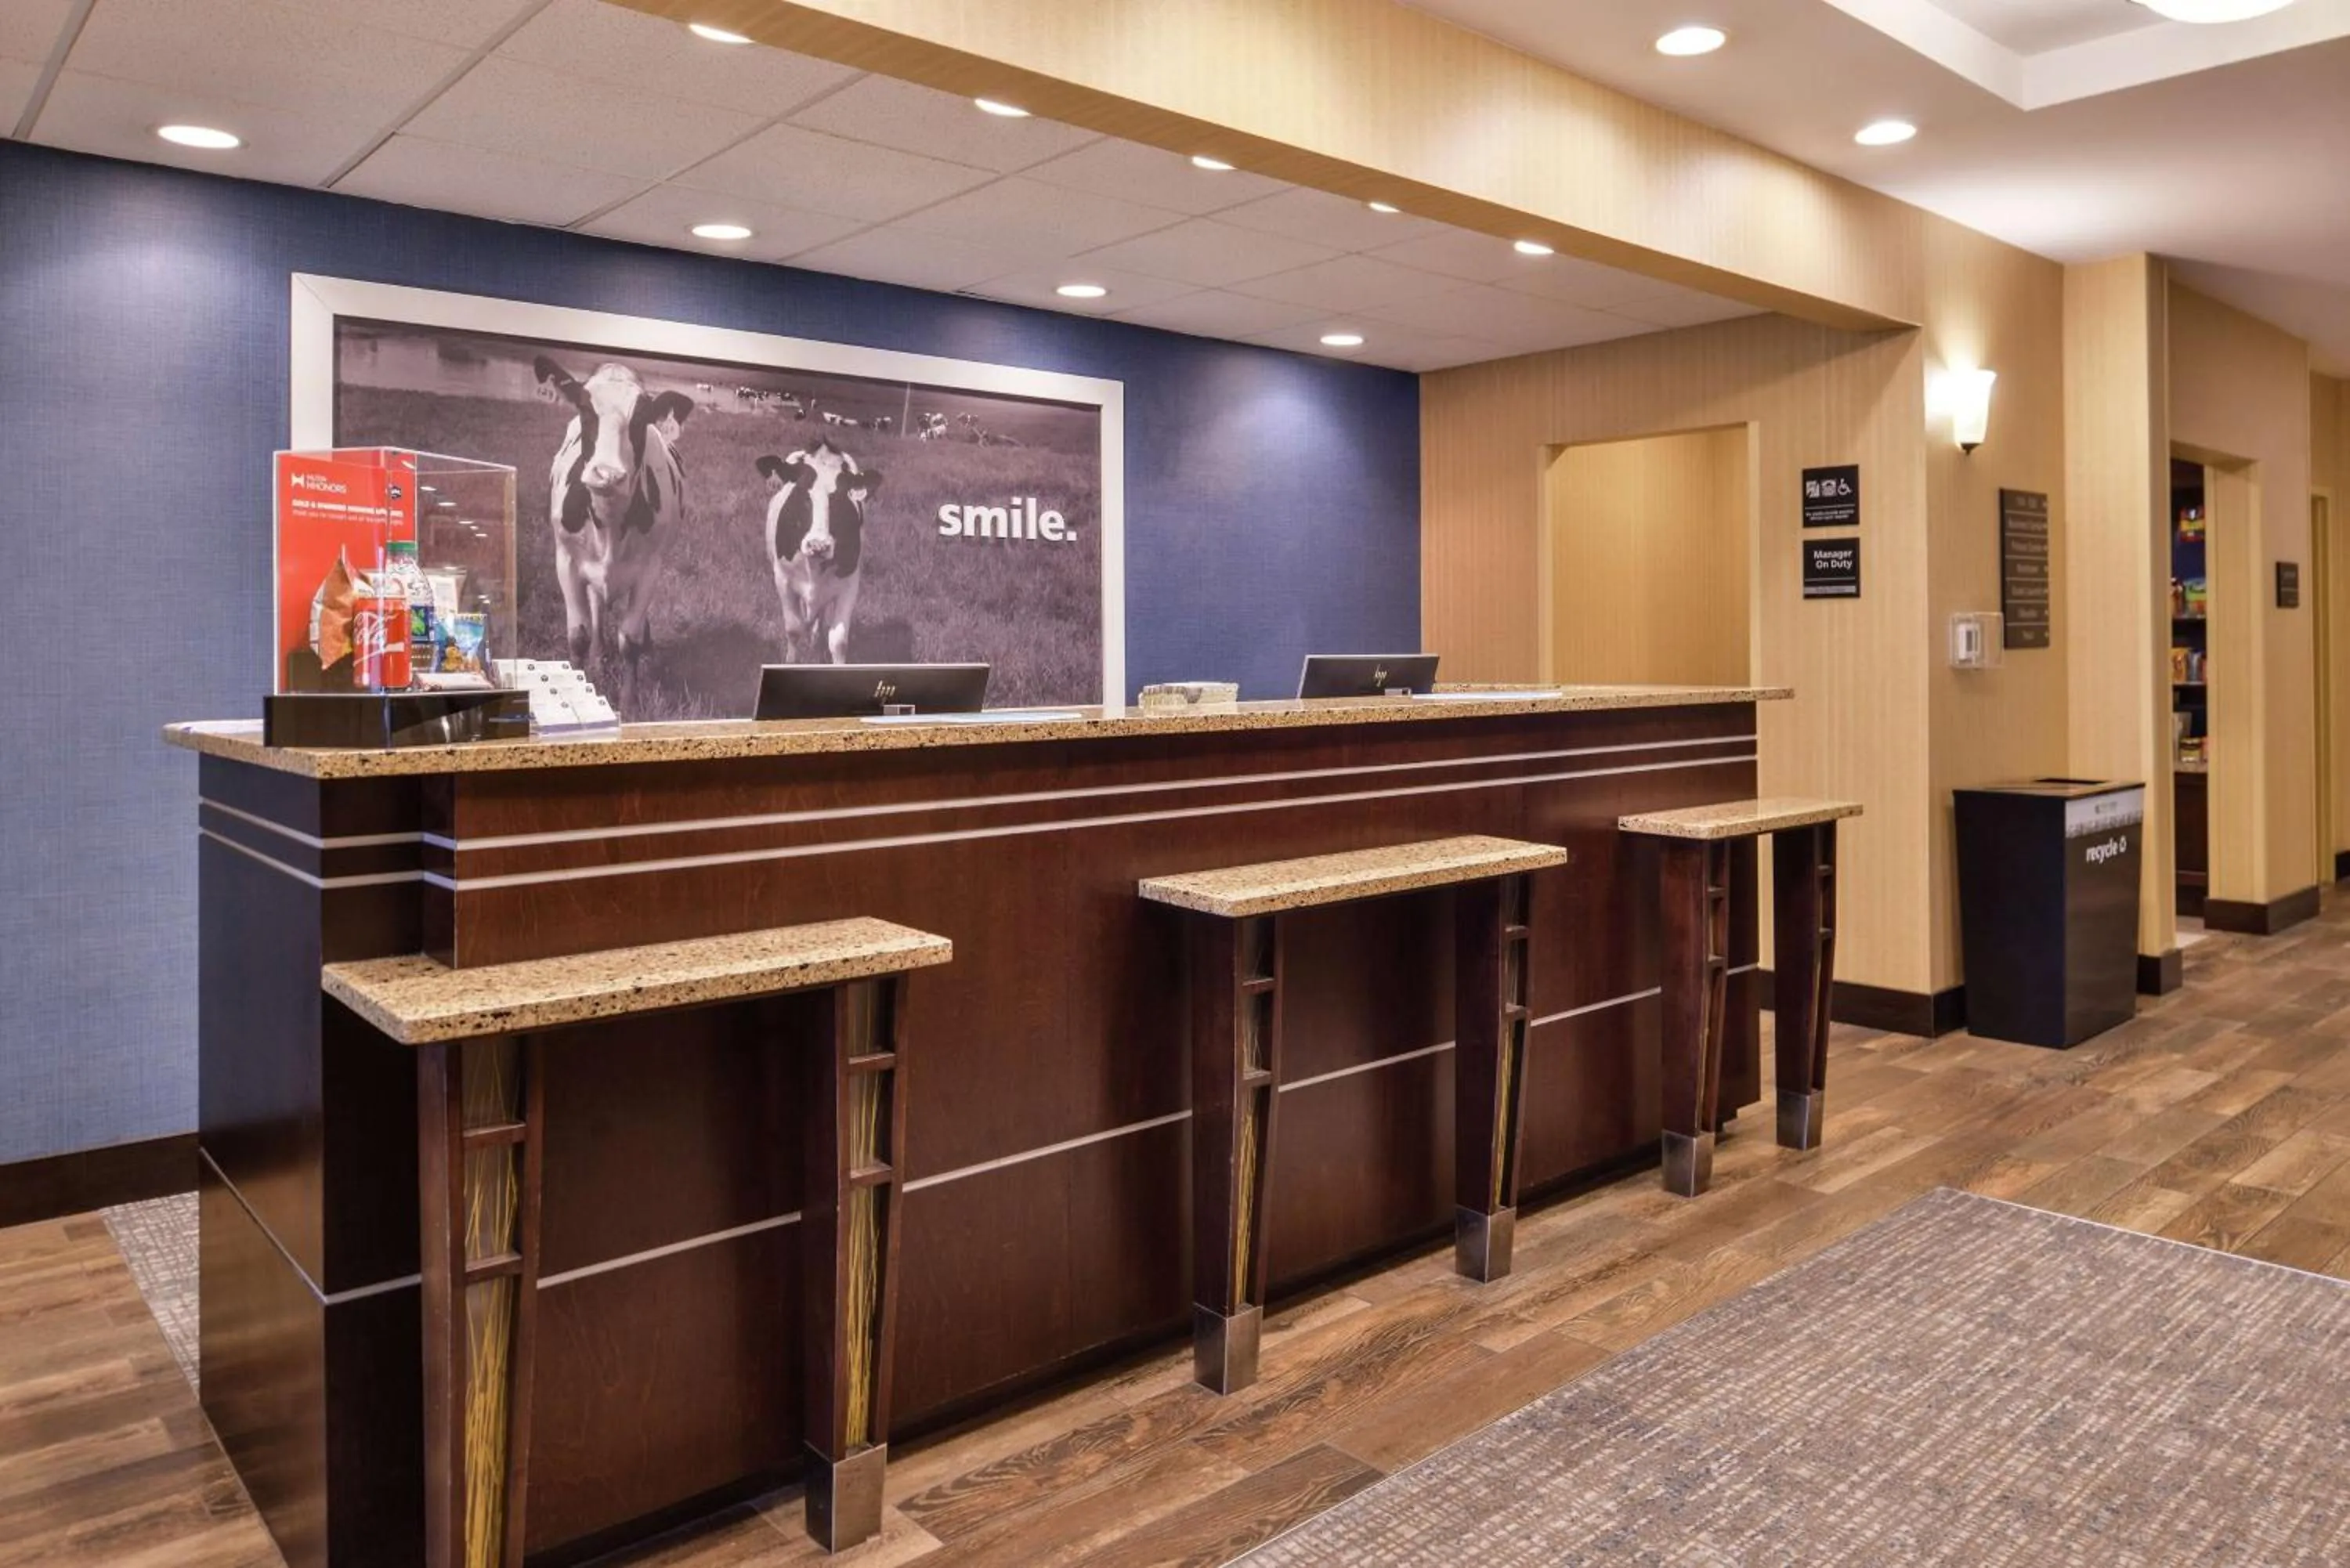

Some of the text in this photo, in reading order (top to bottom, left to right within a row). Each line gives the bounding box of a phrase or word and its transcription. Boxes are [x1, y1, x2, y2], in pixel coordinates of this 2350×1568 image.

[938, 497, 1077, 542] smile.
[1813, 550, 1853, 560] Manager
[1816, 559, 1853, 570] On Duty
[2085, 836, 2119, 865] recycle
